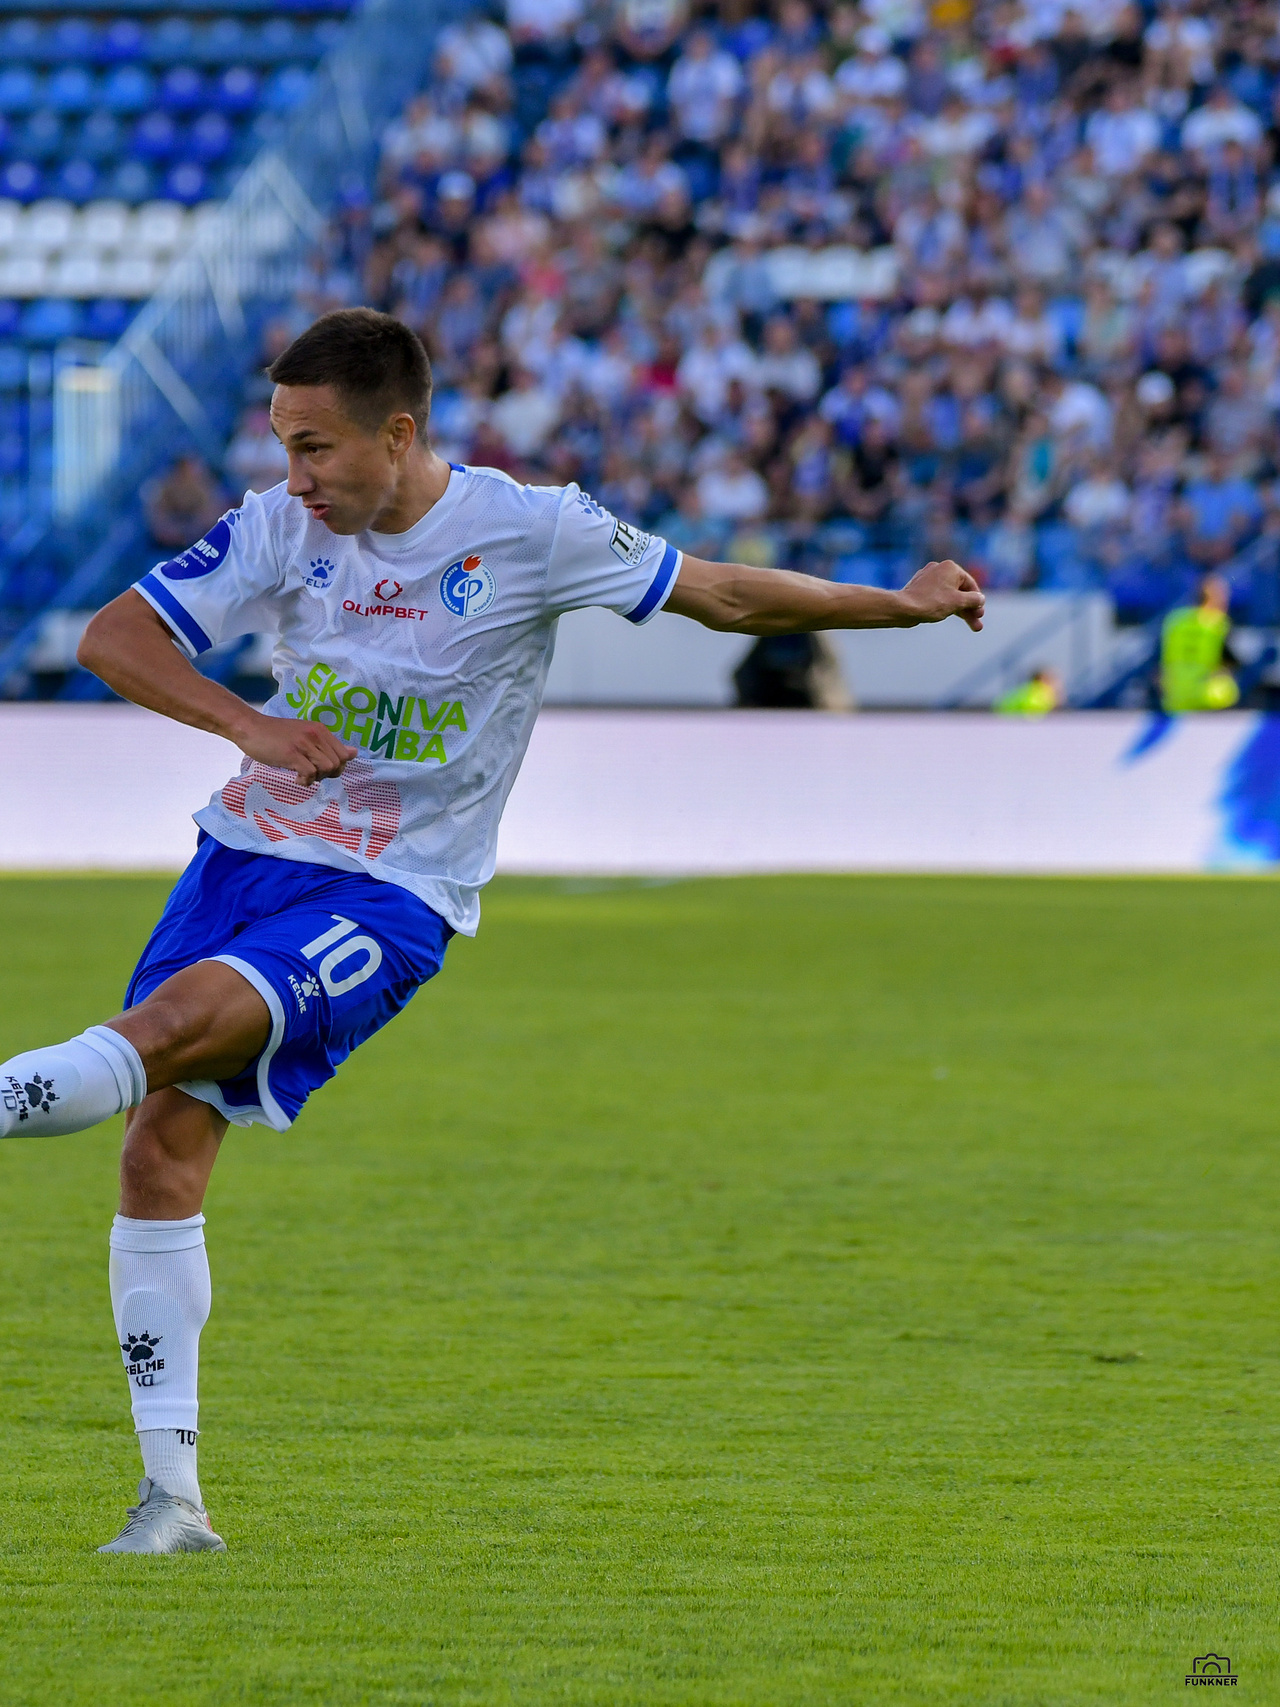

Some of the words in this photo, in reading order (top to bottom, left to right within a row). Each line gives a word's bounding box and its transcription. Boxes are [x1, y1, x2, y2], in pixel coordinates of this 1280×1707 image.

[342, 599, 428, 621] OLIMPBET
[307, 662, 467, 732] EKONIVA
[300, 914, 382, 997] 10
[287, 974, 307, 1014] KELME
[4, 1076, 29, 1122] KELME
